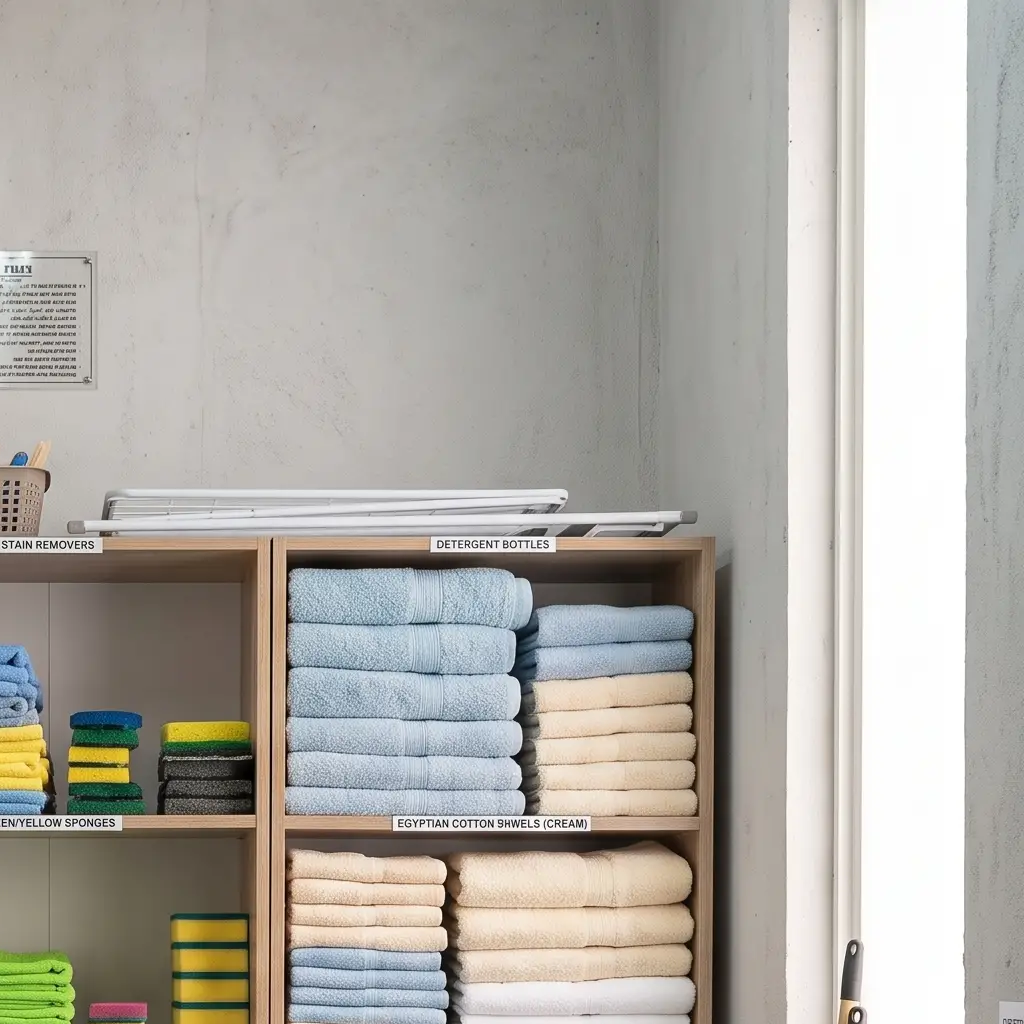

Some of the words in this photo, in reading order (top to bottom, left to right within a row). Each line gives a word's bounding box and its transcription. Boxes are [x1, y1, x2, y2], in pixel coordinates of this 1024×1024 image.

[1, 540, 33, 550] STAIN
[36, 540, 95, 550] REMOVERS
[436, 539, 500, 549] DETERGENT
[502, 539, 550, 549] BOTTLES
[64, 818, 116, 828] SPONGES
[397, 819, 449, 829] EGYPTIAN
[452, 819, 495, 829] COTTON
[543, 818, 588, 830] (CREAM)
